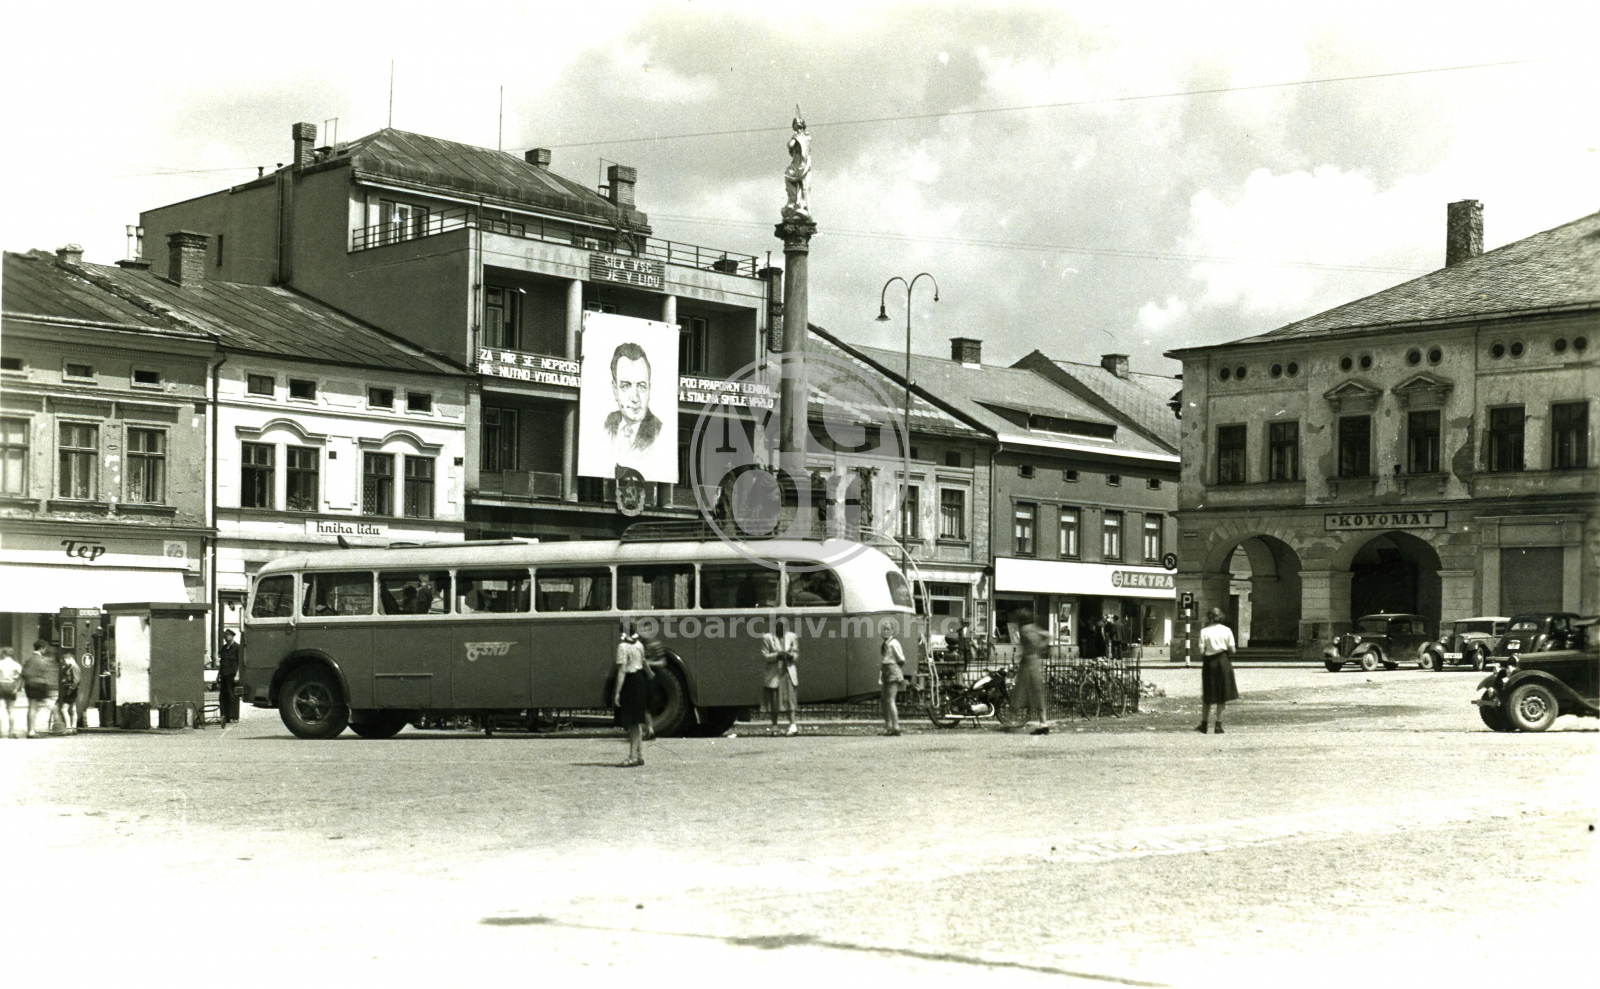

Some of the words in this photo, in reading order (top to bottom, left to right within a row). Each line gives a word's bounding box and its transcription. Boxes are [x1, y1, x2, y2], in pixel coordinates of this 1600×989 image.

[606, 269, 619, 282] JE
[626, 272, 633, 284] V
[638, 273, 660, 288] LIDU
[479, 349, 494, 361] ZA
[500, 366, 531, 381] NUTNO
[680, 377, 697, 389] POD
[679, 391, 685, 402] A
[1338, 513, 1433, 527] KOVOMAT
[357, 523, 380, 535] lidu
[61, 540, 106, 562] Tep
[1112, 573, 1174, 588] ELEKTRA
[1182, 594, 1192, 608] P
